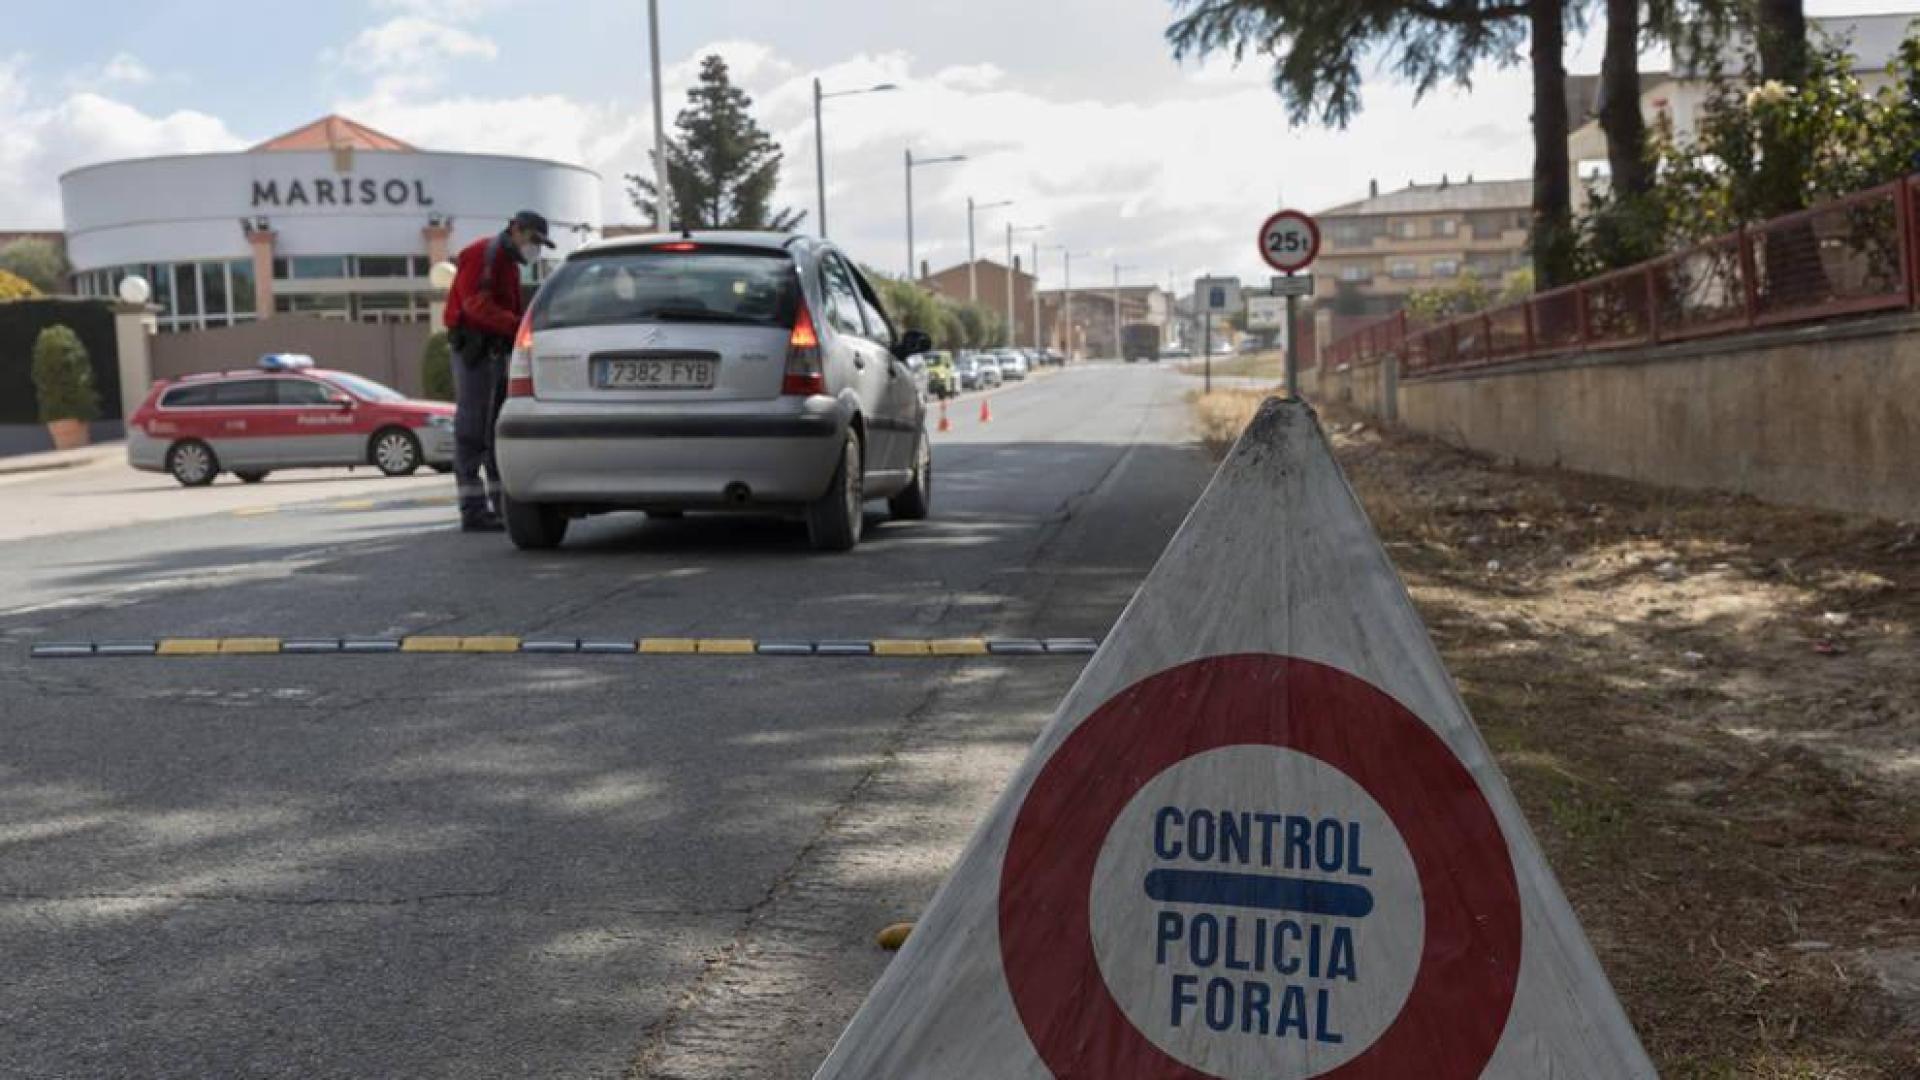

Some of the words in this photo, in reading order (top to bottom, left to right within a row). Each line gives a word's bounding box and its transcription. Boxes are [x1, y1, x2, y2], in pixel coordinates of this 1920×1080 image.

[251, 177, 434, 207] MARISOL
[613, 362, 662, 383] 7382
[671, 362, 709, 383] FYB
[1154, 805, 1372, 876] CONTROL
[1156, 911, 1357, 982] POLICIA
[1171, 974, 1344, 1043] FORAL
